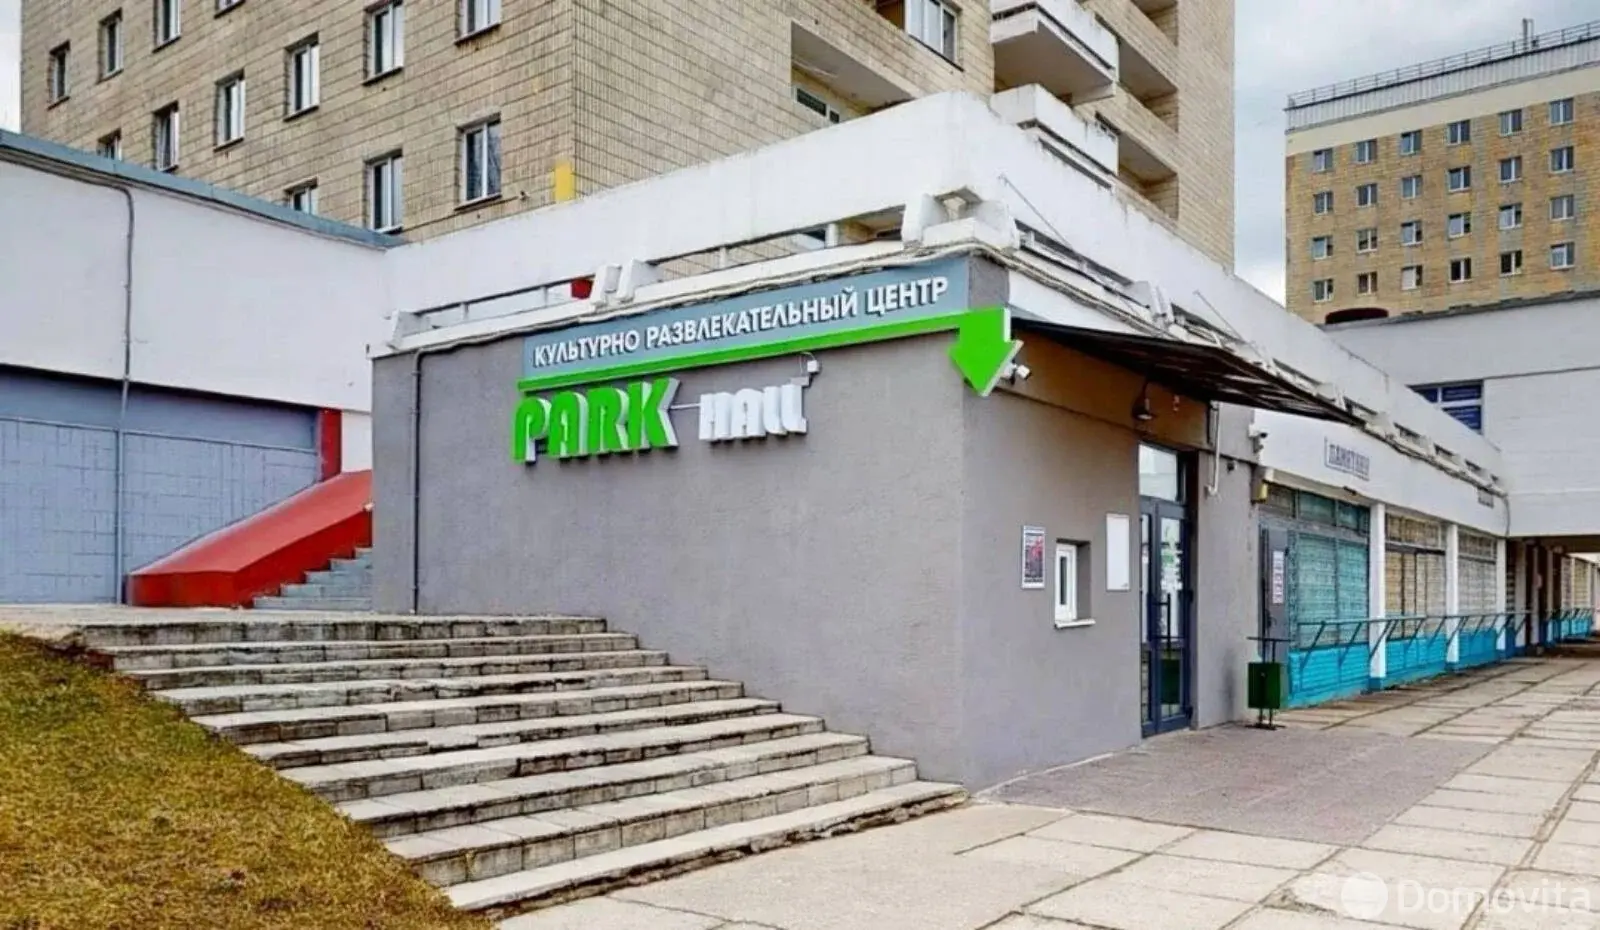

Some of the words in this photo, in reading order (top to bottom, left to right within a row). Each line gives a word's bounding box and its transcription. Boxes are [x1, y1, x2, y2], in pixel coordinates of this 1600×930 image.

[533, 329, 640, 368] КУЛЬТУРНО
[645, 285, 859, 350] РАЗВЛЕКАТЕЛЬНЫЙ
[866, 275, 949, 317] ЦЕНТР
[513, 377, 680, 463] PARK
